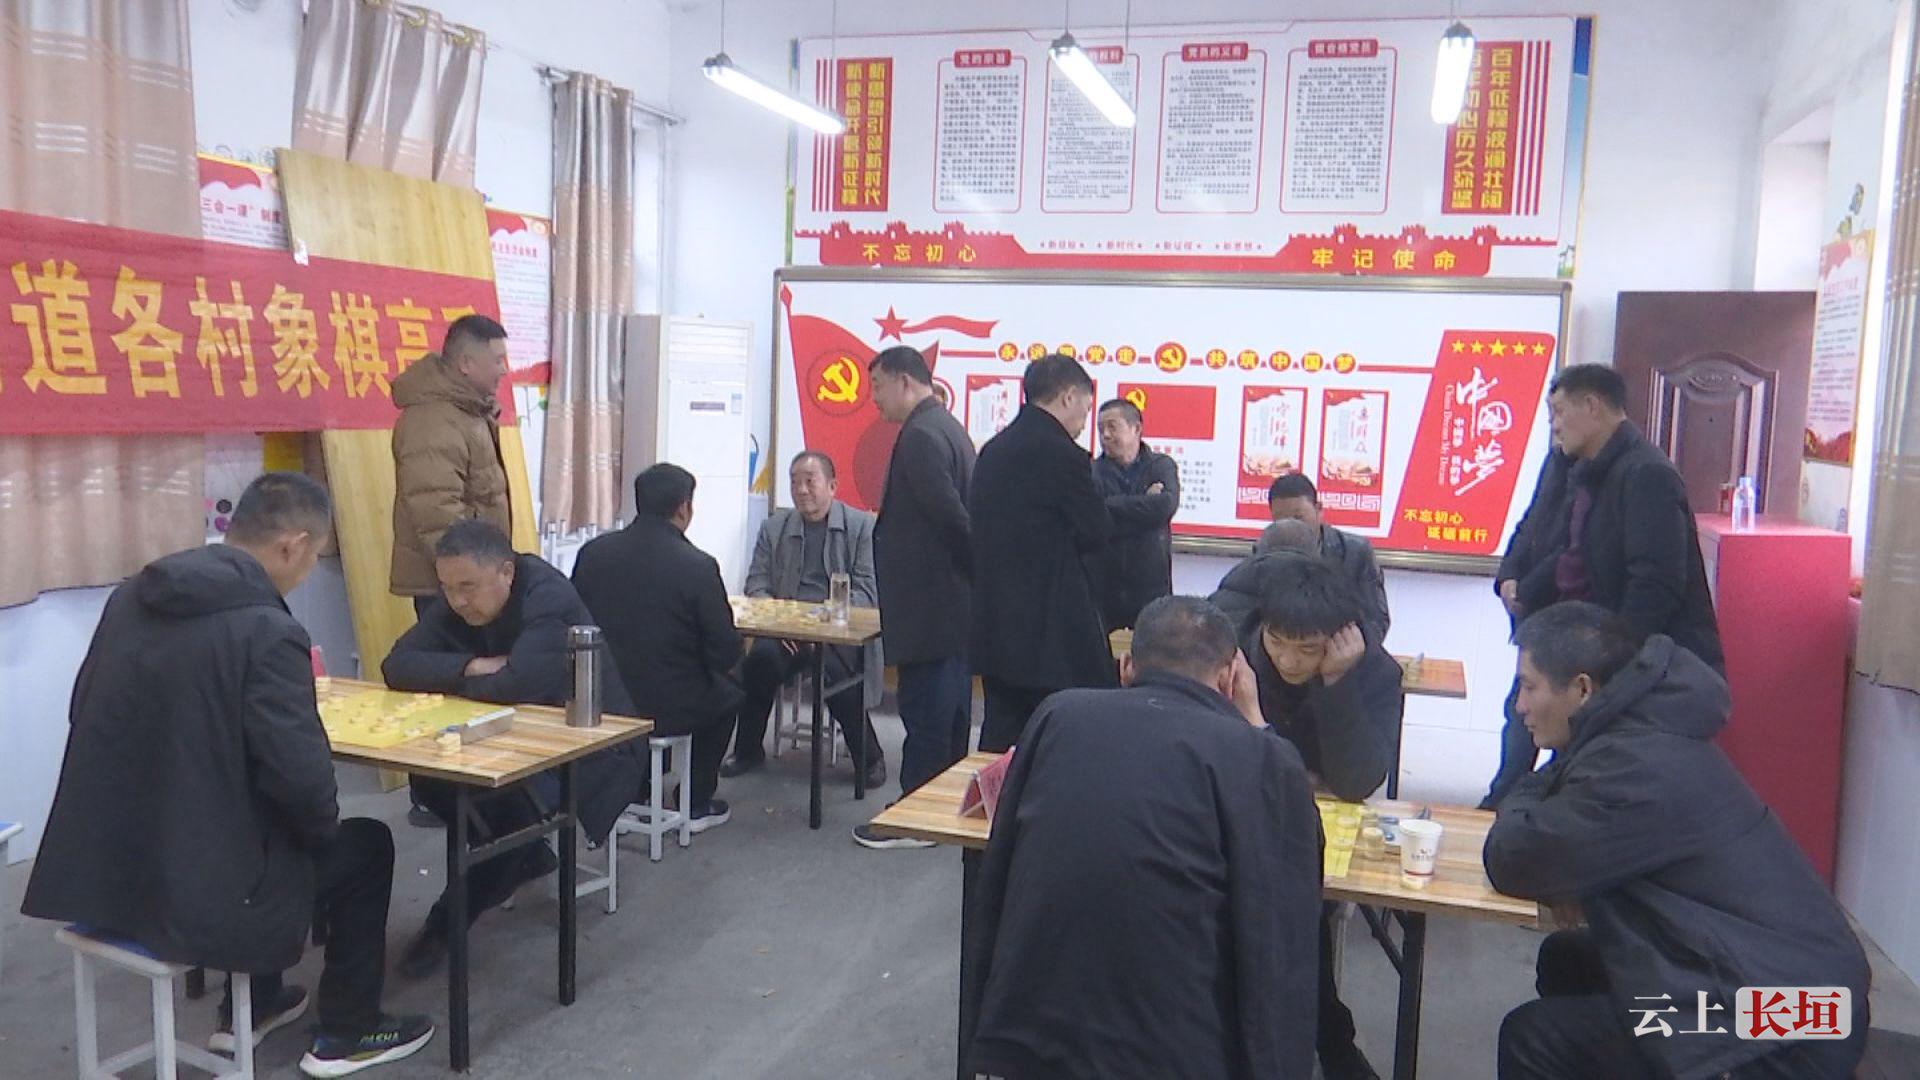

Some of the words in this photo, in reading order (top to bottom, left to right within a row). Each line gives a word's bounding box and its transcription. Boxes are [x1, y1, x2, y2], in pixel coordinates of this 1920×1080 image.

[864, 62, 885, 206] 新思想引领新时代
[1481, 48, 1512, 209] 百年征程波澜壮阔
[862, 243, 977, 263] 不忘初心
[1311, 247, 1456, 271] 牢记使命
[10, 258, 476, 399] 道各村象棋高
[1208, 350, 1355, 373] 共筑中国梦
[1455, 366, 1513, 497] 中国梦
[1404, 508, 1464, 525] 不忘初心
